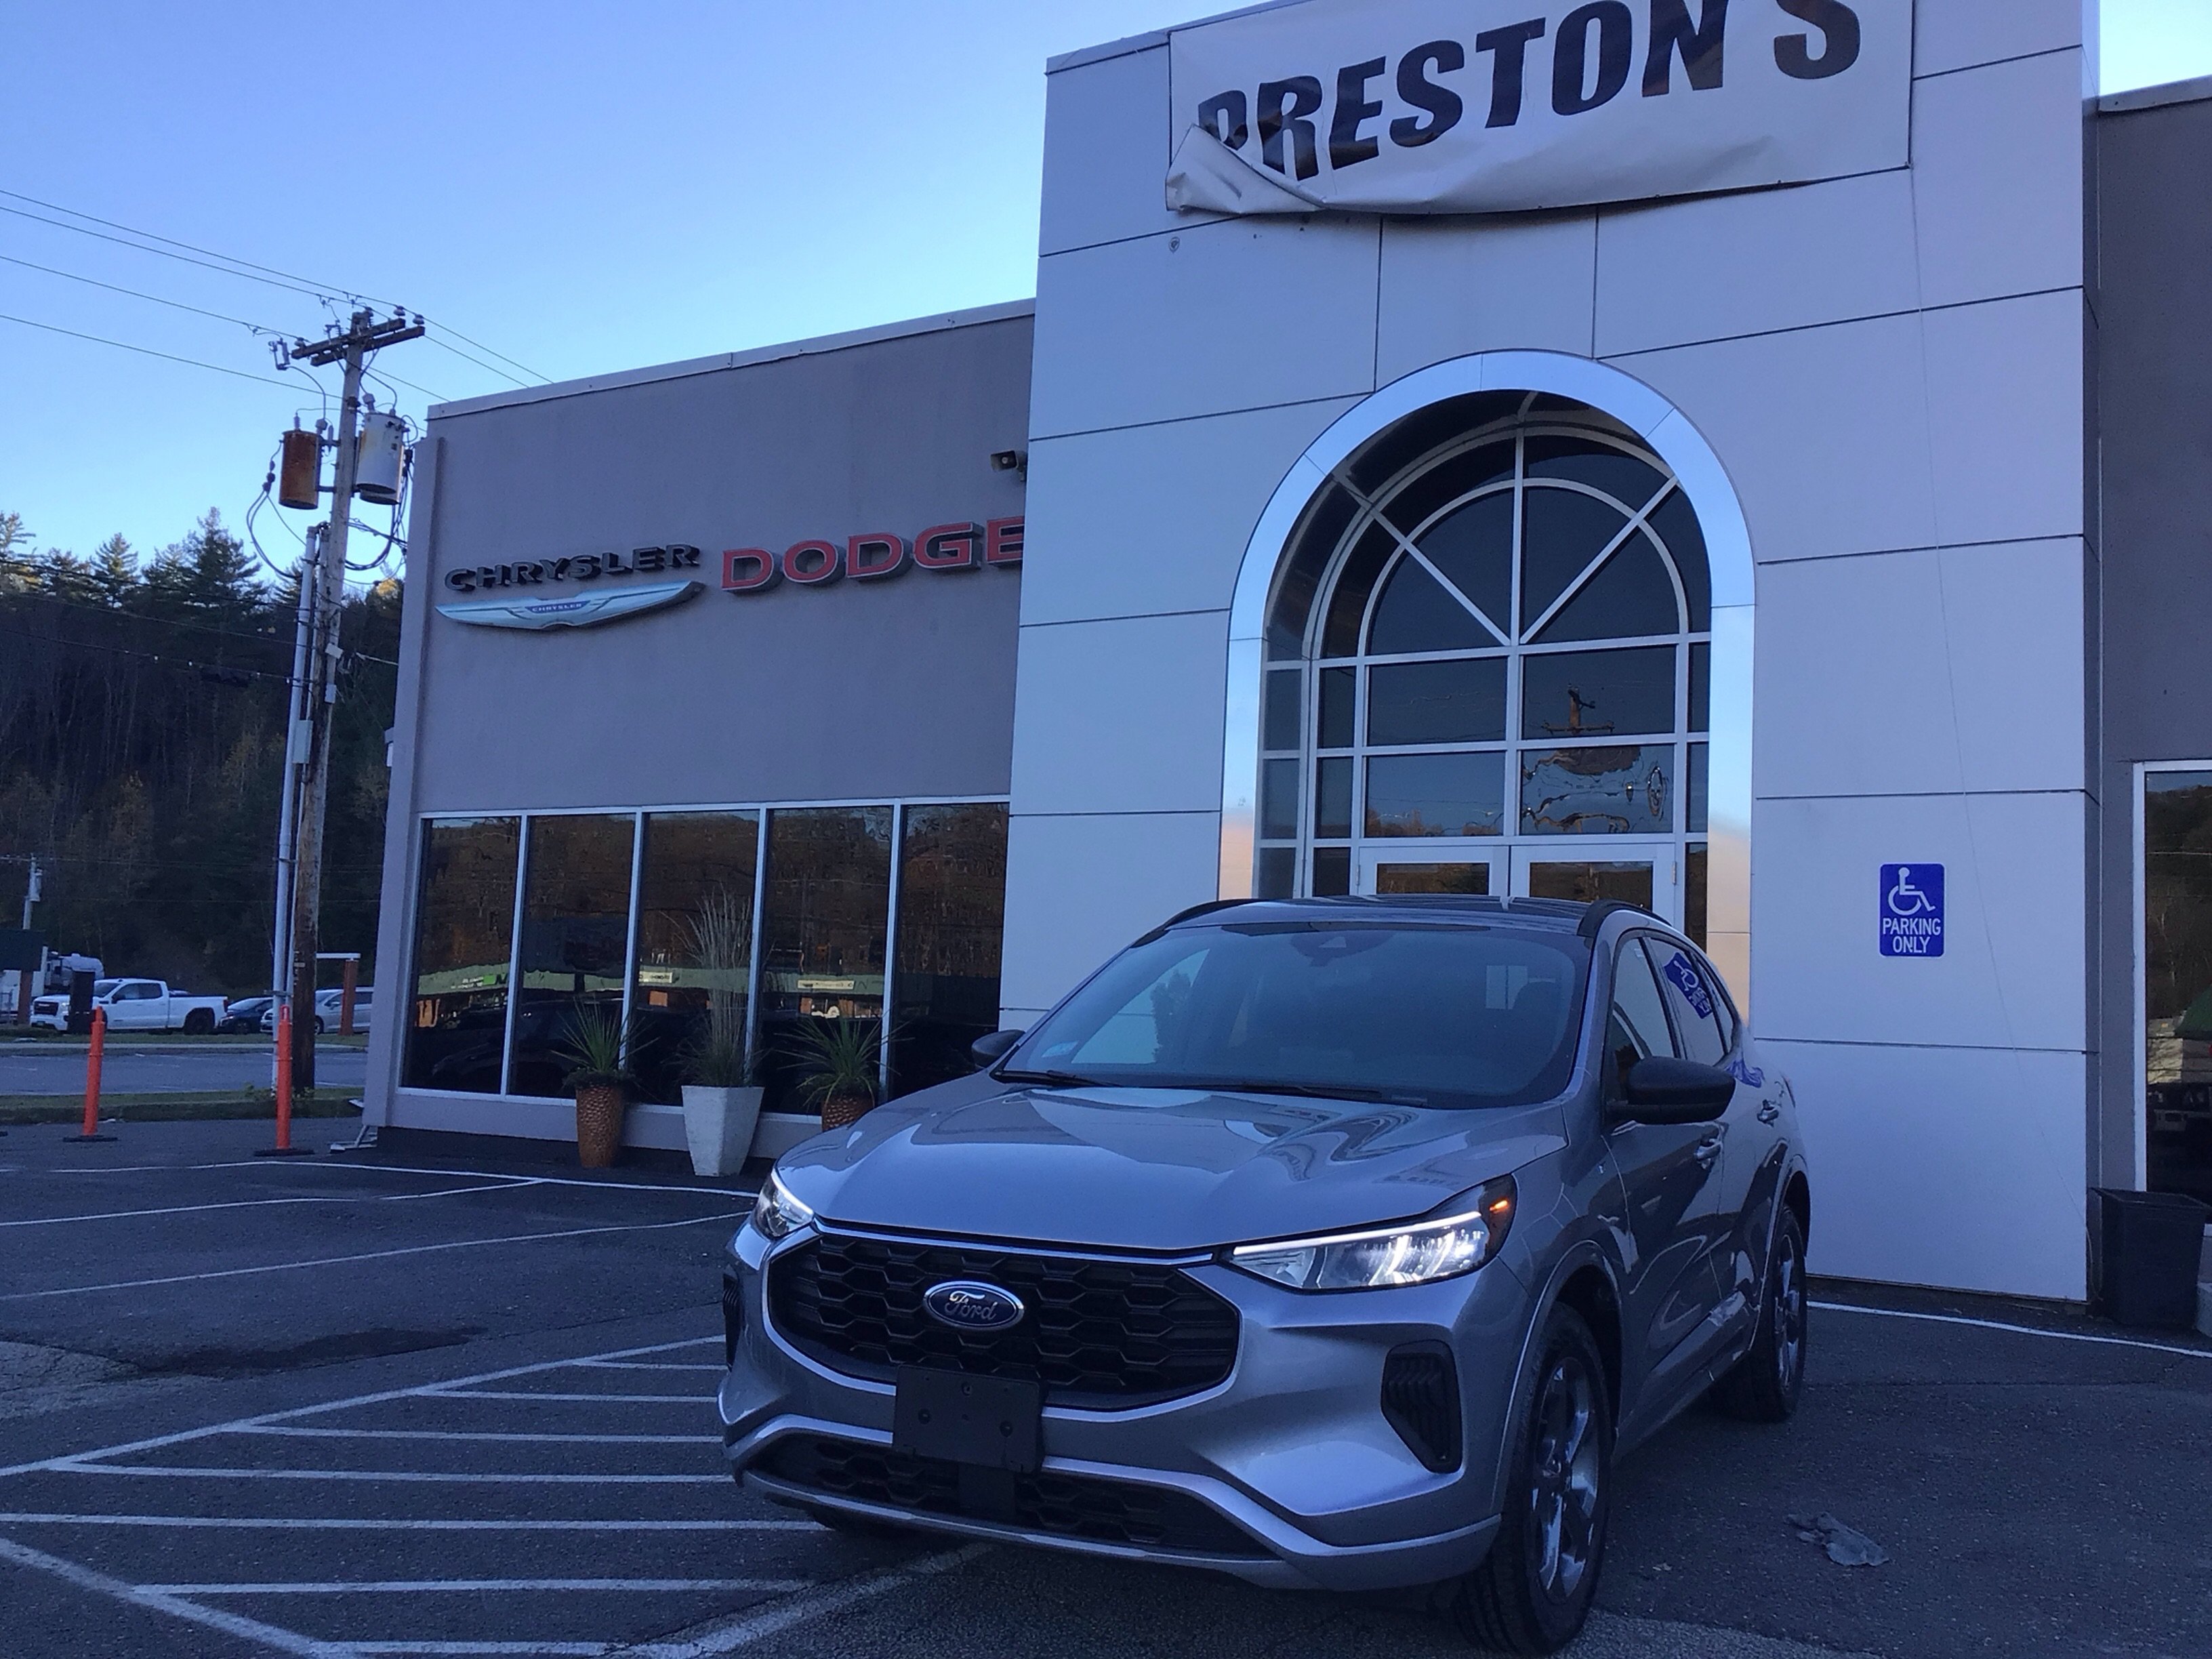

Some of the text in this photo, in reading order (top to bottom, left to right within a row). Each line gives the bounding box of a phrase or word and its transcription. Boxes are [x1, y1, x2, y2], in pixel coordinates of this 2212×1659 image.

[445, 543, 699, 592] CHRYSLER
[721, 516, 1025, 592] DODGE
[1882, 918, 1942, 935] PARKING
[1892, 935, 1931, 954] ONLY
[944, 1290, 998, 1320] Ford
